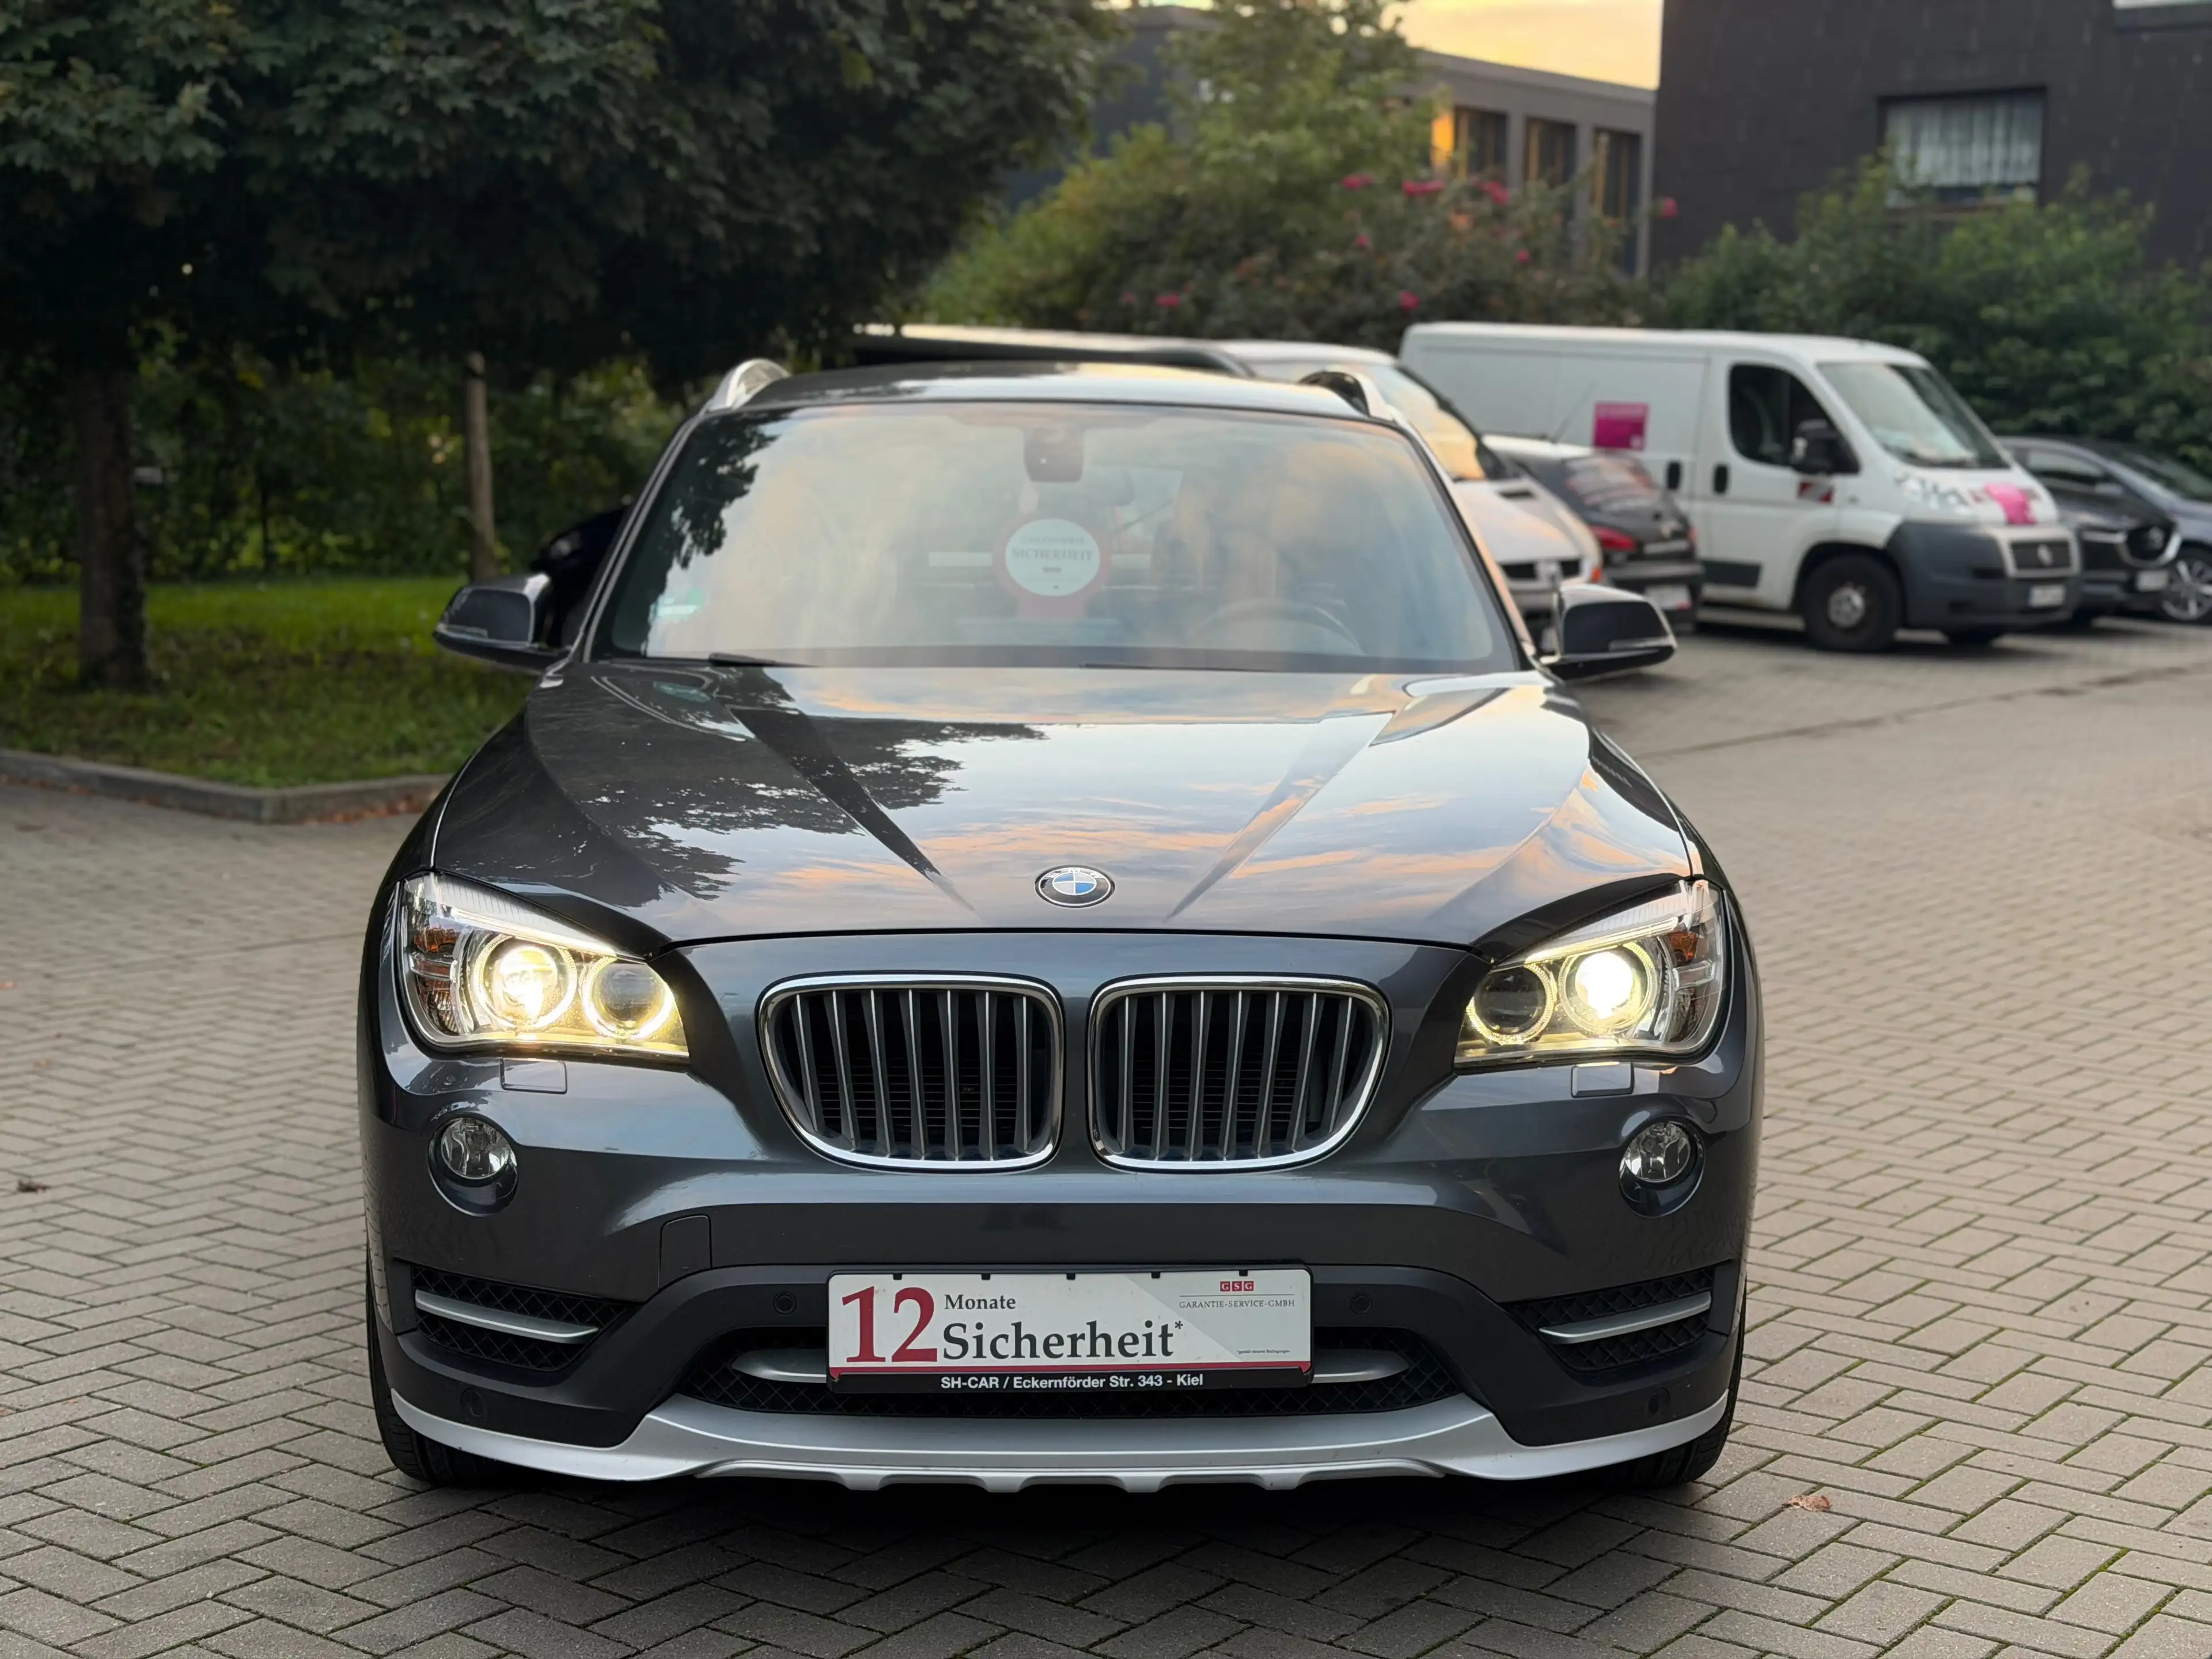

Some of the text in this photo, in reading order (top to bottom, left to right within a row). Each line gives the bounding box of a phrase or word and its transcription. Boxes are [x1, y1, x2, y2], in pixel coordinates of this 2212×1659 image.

[1221, 1282, 1253, 1291] GSG
[944, 1294, 1016, 1309] Monate
[1179, 1300, 1295, 1308] GARANTIE-SERVICE-GMBH
[842, 1286, 938, 1362] 12
[941, 1376, 999, 1389] SH-CAR
[1003, 1376, 1009, 1389] /
[1013, 1376, 1106, 1388] Eckernförder
[1109, 1375, 1134, 1388] Str.
[1138, 1374, 1163, 1387] 343
[1177, 1373, 1203, 1386] Kiel
